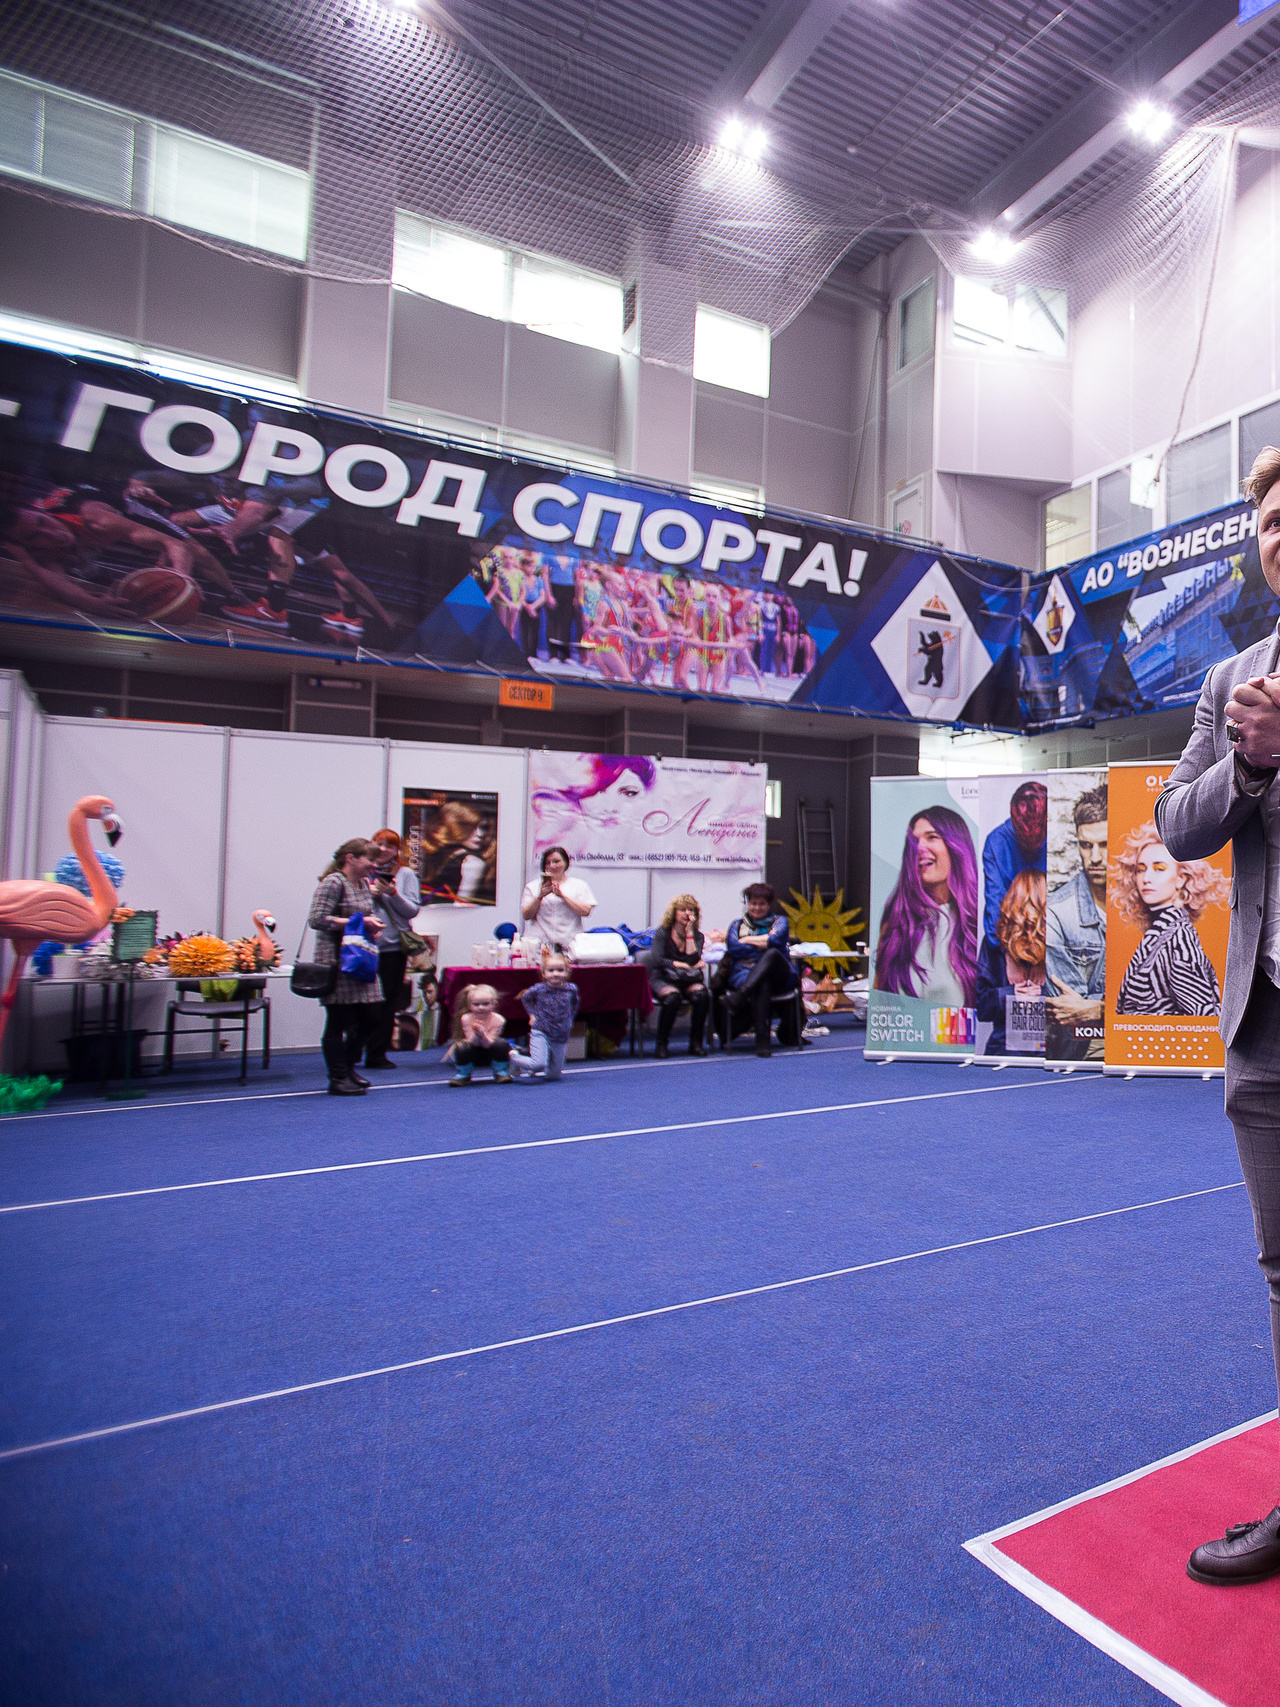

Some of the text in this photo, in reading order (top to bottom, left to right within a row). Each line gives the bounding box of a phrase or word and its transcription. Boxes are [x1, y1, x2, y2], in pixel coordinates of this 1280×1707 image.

[61, 382, 487, 538] ГОРОД
[513, 481, 867, 597] СПОРТА!
[1081, 509, 1259, 594] АО “ВОЗНЕСЕН
[870, 1014, 914, 1027] COLOR
[1113, 1023, 1219, 1032] ПРЕВОСХОДИТЬ ОЖИДАНИ
[870, 1028, 925, 1042] SWITCH
